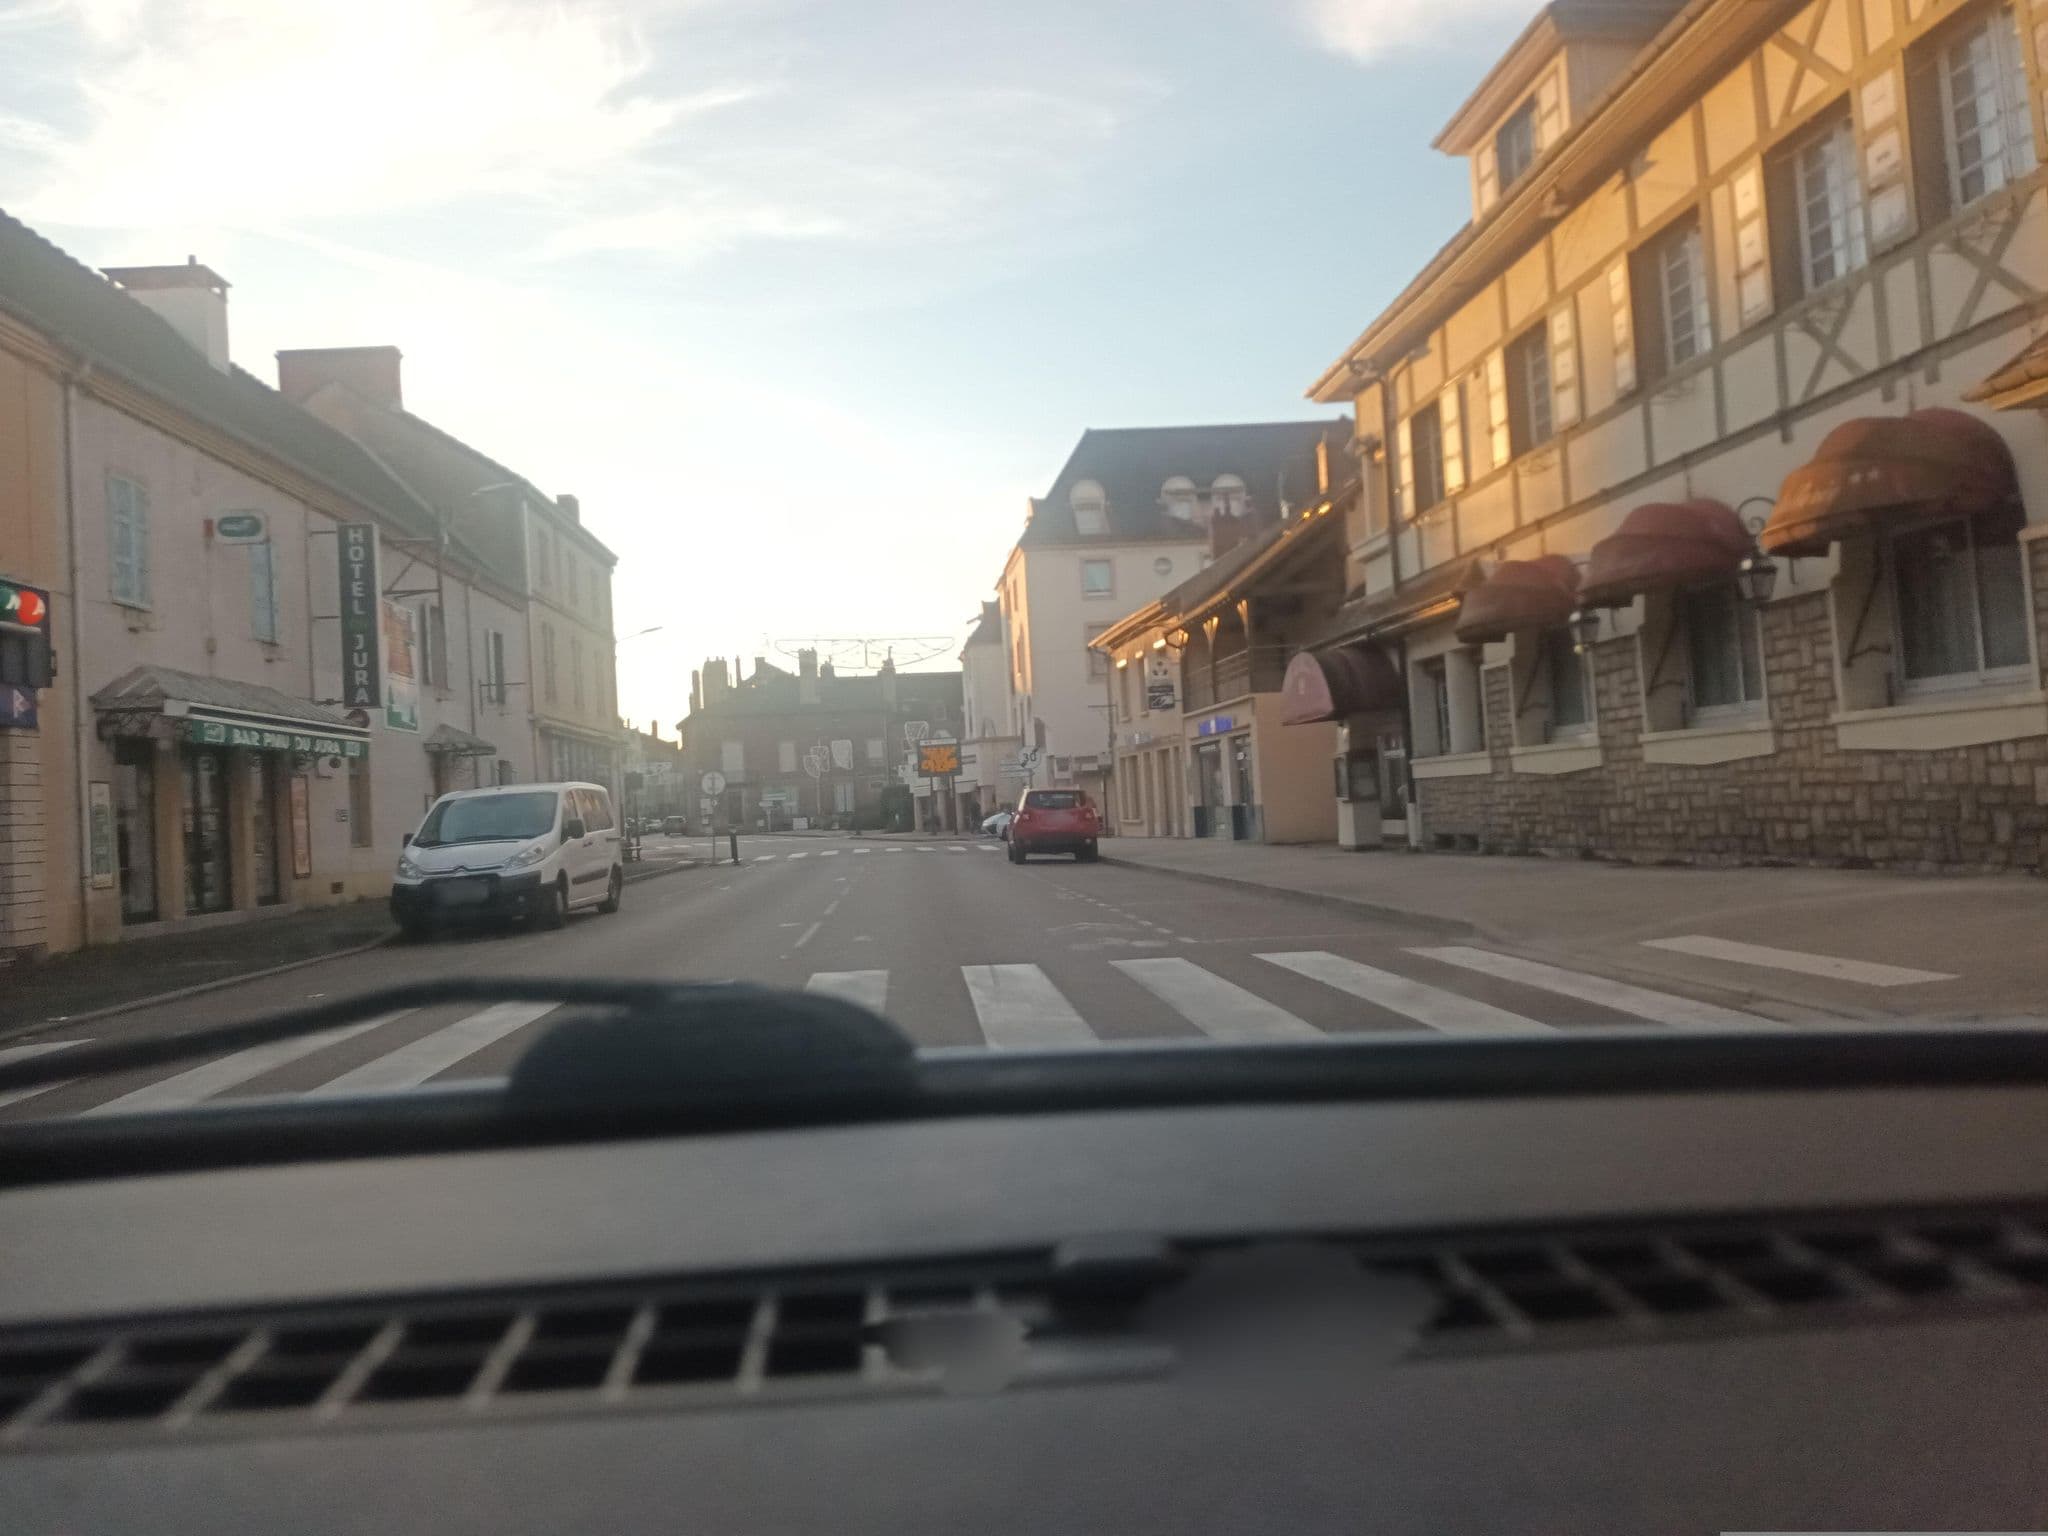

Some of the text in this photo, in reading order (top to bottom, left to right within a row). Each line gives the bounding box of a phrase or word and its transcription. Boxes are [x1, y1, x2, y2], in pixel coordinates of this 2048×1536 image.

[350, 528, 366, 615] HOTEL
[354, 634, 369, 703] JURA
[231, 728, 261, 746] BAR
[314, 739, 342, 753] JURA
[1023, 752, 1037, 762] 30
